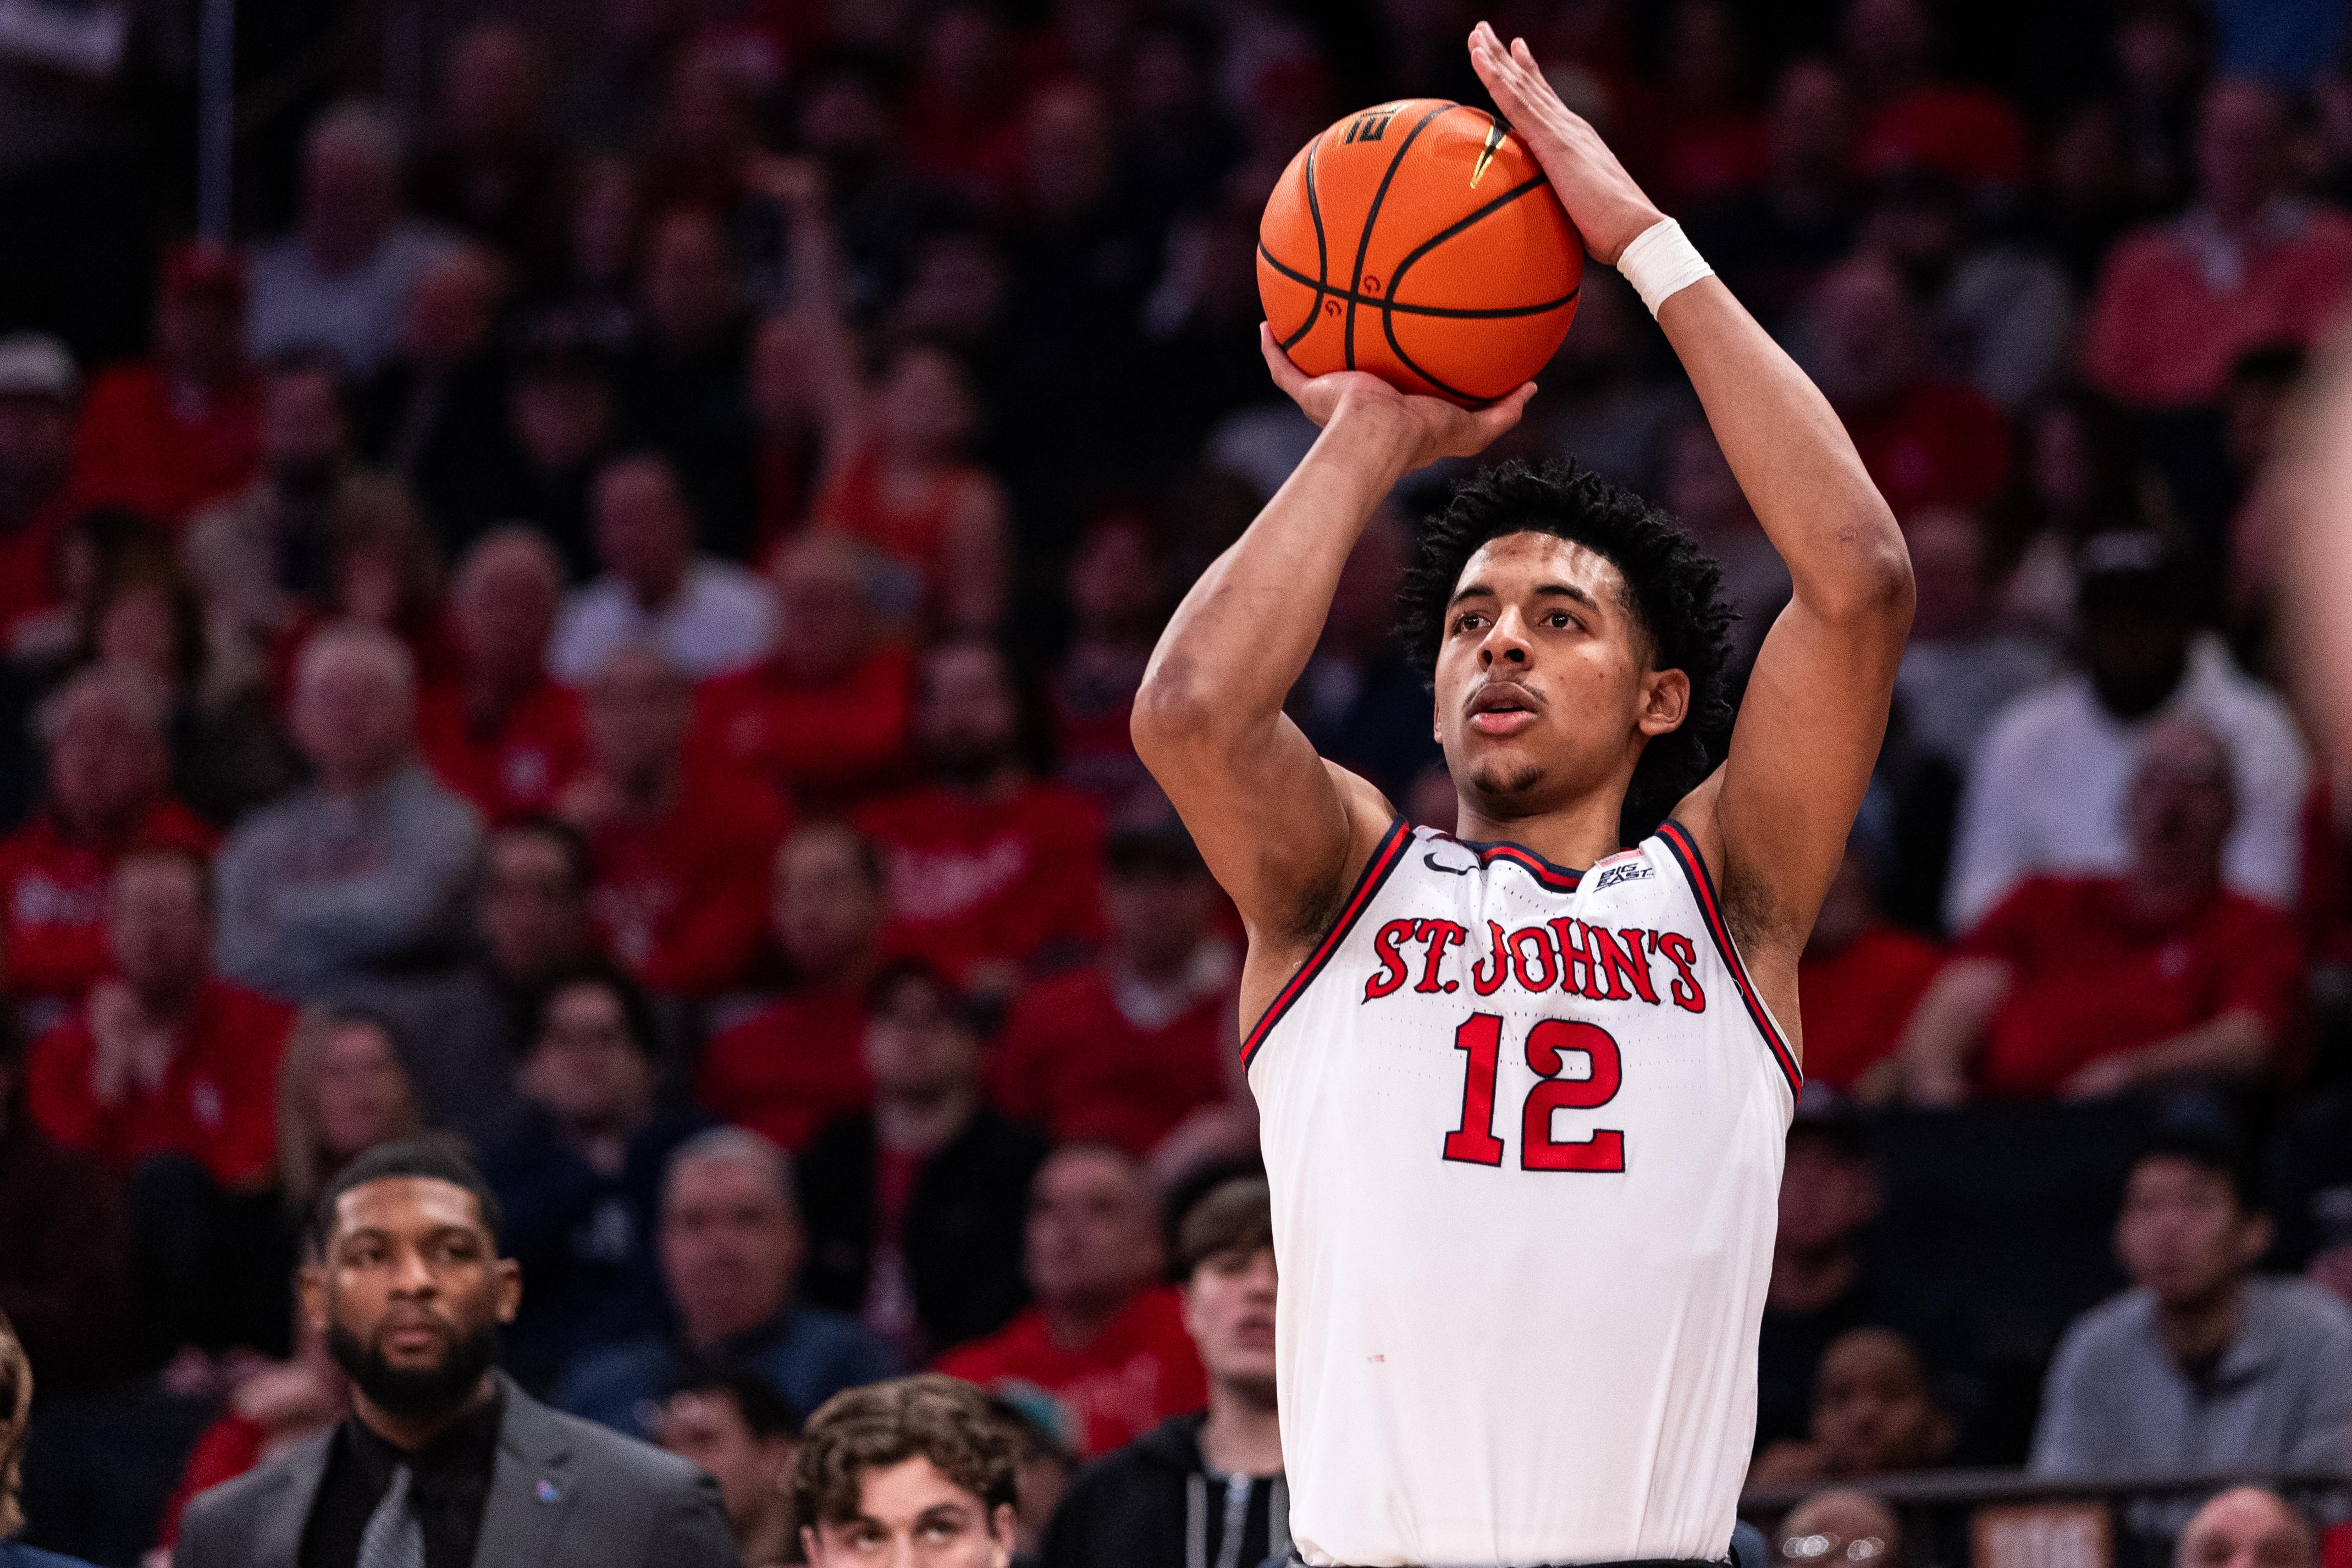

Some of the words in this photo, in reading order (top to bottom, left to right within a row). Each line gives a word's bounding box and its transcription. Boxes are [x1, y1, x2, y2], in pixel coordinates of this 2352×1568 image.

[1596, 868, 1652, 888] EAST
[1600, 863, 1638, 880] BIG
[1361, 918, 1469, 1005] ST.
[1471, 916, 1706, 1014] JOHN'S
[1442, 1012, 1626, 1173] 12
